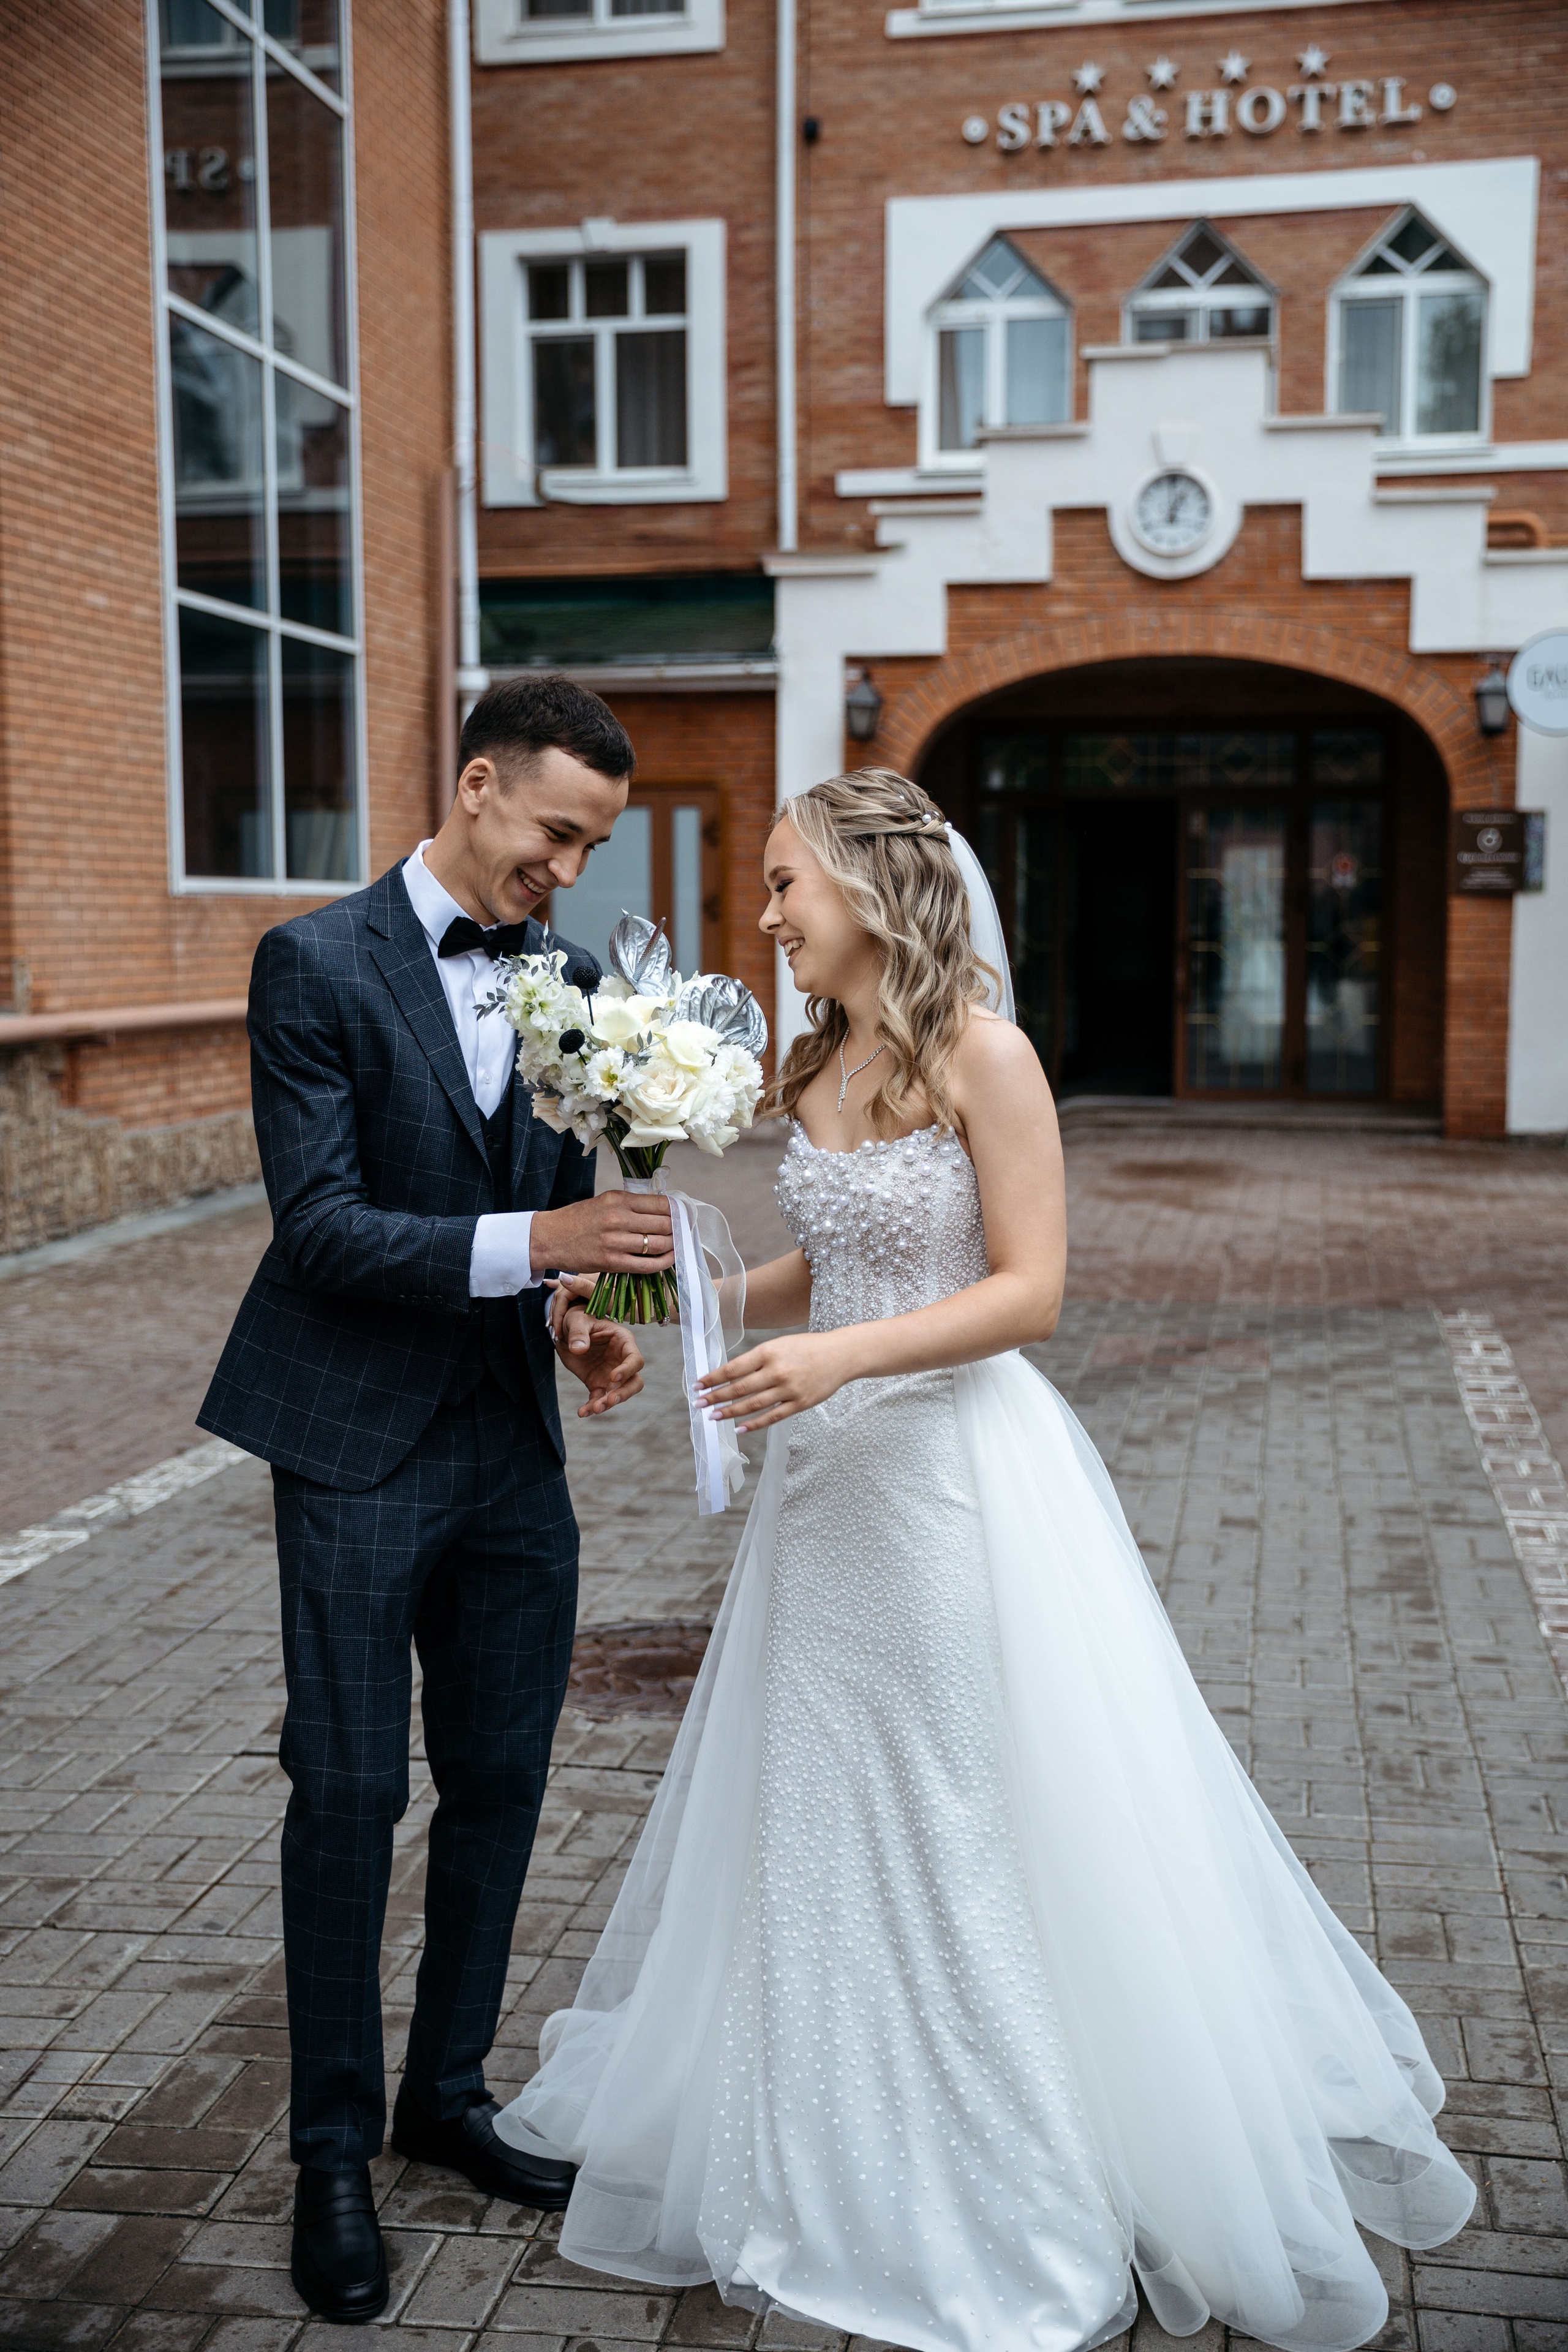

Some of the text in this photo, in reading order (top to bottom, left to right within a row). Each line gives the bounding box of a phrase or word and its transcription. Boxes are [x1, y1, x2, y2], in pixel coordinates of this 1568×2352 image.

[997, 77, 1422, 151] SPA & HOTEL
